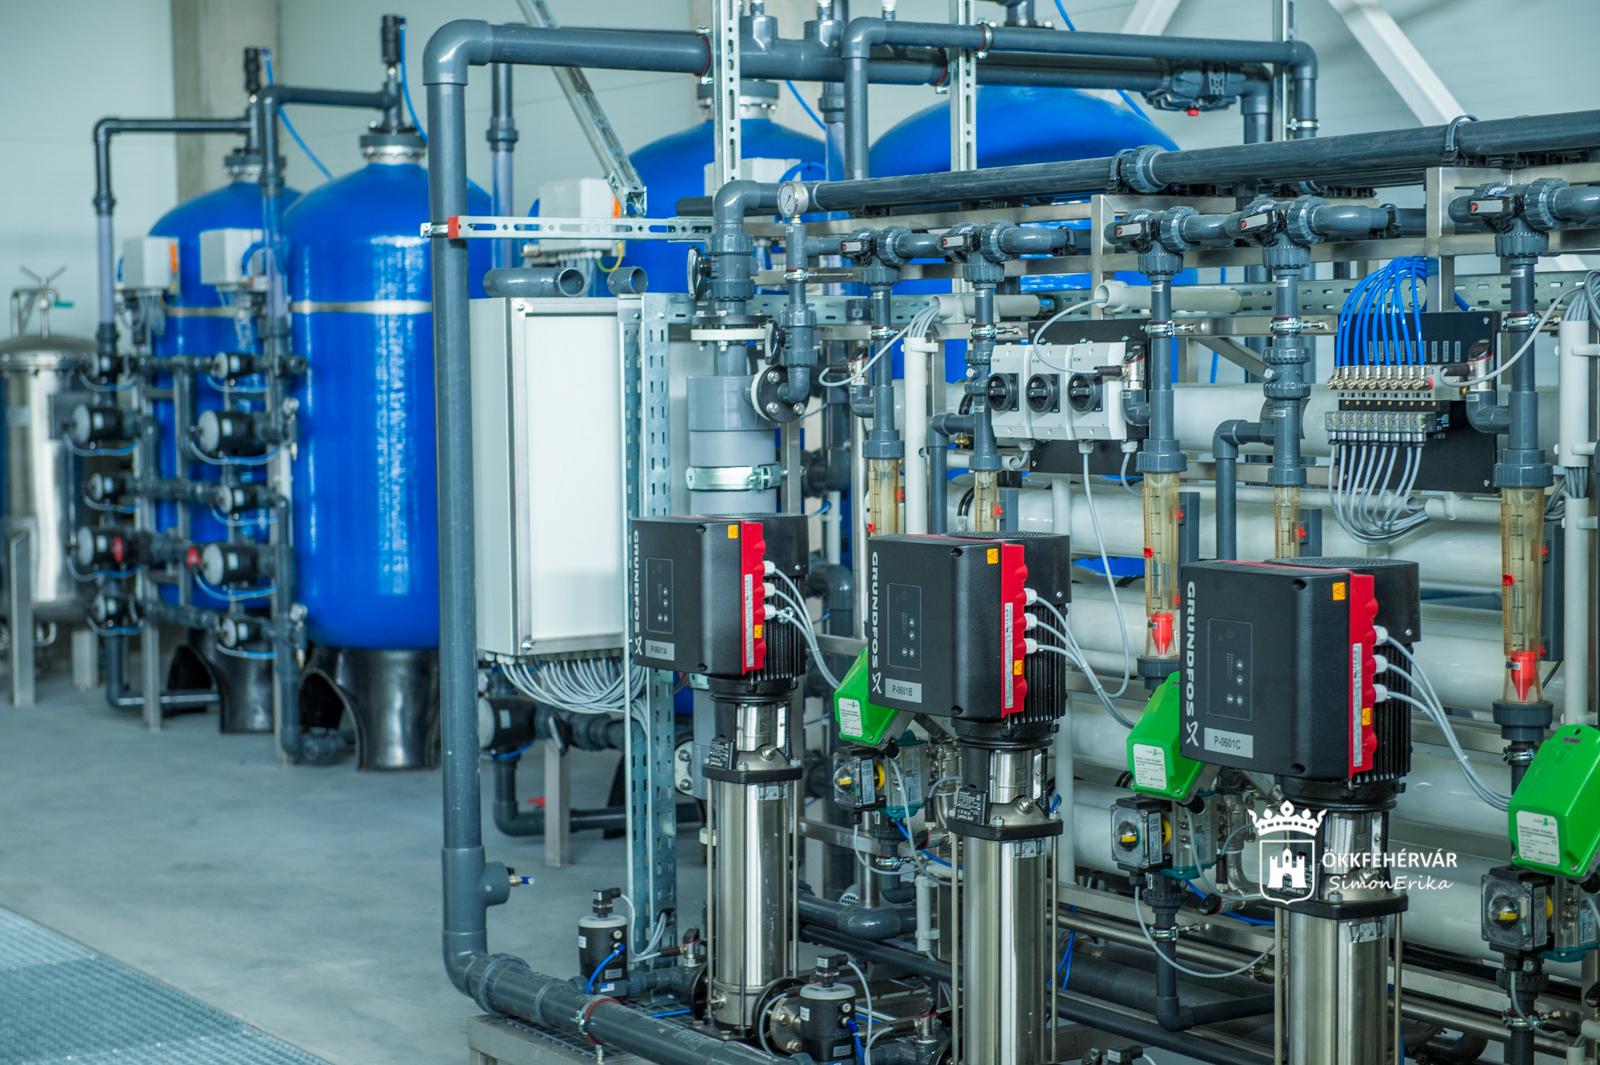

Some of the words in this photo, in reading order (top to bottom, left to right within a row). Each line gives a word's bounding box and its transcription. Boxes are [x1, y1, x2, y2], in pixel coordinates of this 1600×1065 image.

[1186, 580, 1196, 717] GRUNDFOS
[891, 685, 913, 696] P-0601B
[1213, 735, 1242, 750] P-0601C
